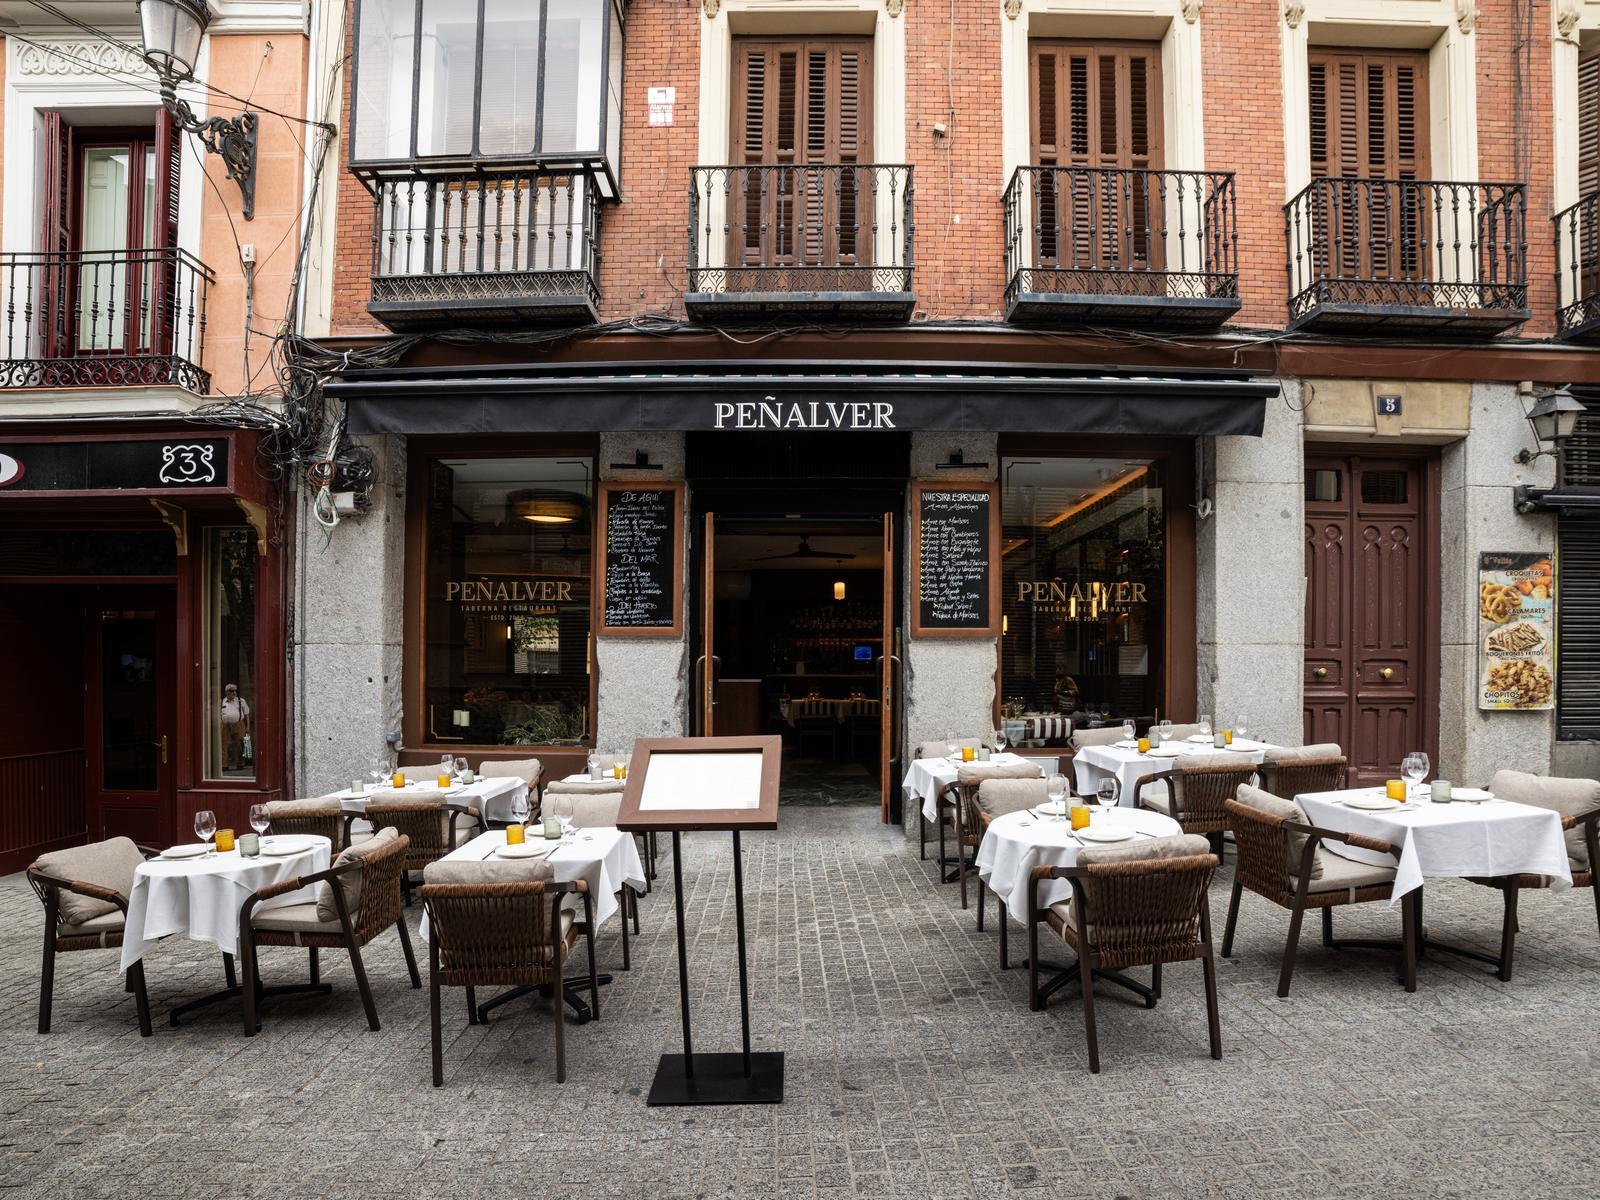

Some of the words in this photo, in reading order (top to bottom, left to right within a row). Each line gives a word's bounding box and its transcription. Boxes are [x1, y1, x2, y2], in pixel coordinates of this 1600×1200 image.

[714, 396, 896, 428] PEÑALVER
[1385, 398, 1395, 412] 5
[179, 452, 197, 475] 3
[621, 492, 637, 502] DE
[922, 493, 951, 501] NUESTRA
[952, 493, 990, 502] ESPECIALIDAD
[621, 554, 638, 564] DEL
[640, 554, 660, 564] MAR
[445, 577, 573, 601] PEÑALVER
[1017, 577, 1148, 602] PEÑALVER
[618, 601, 631, 609] DEL
